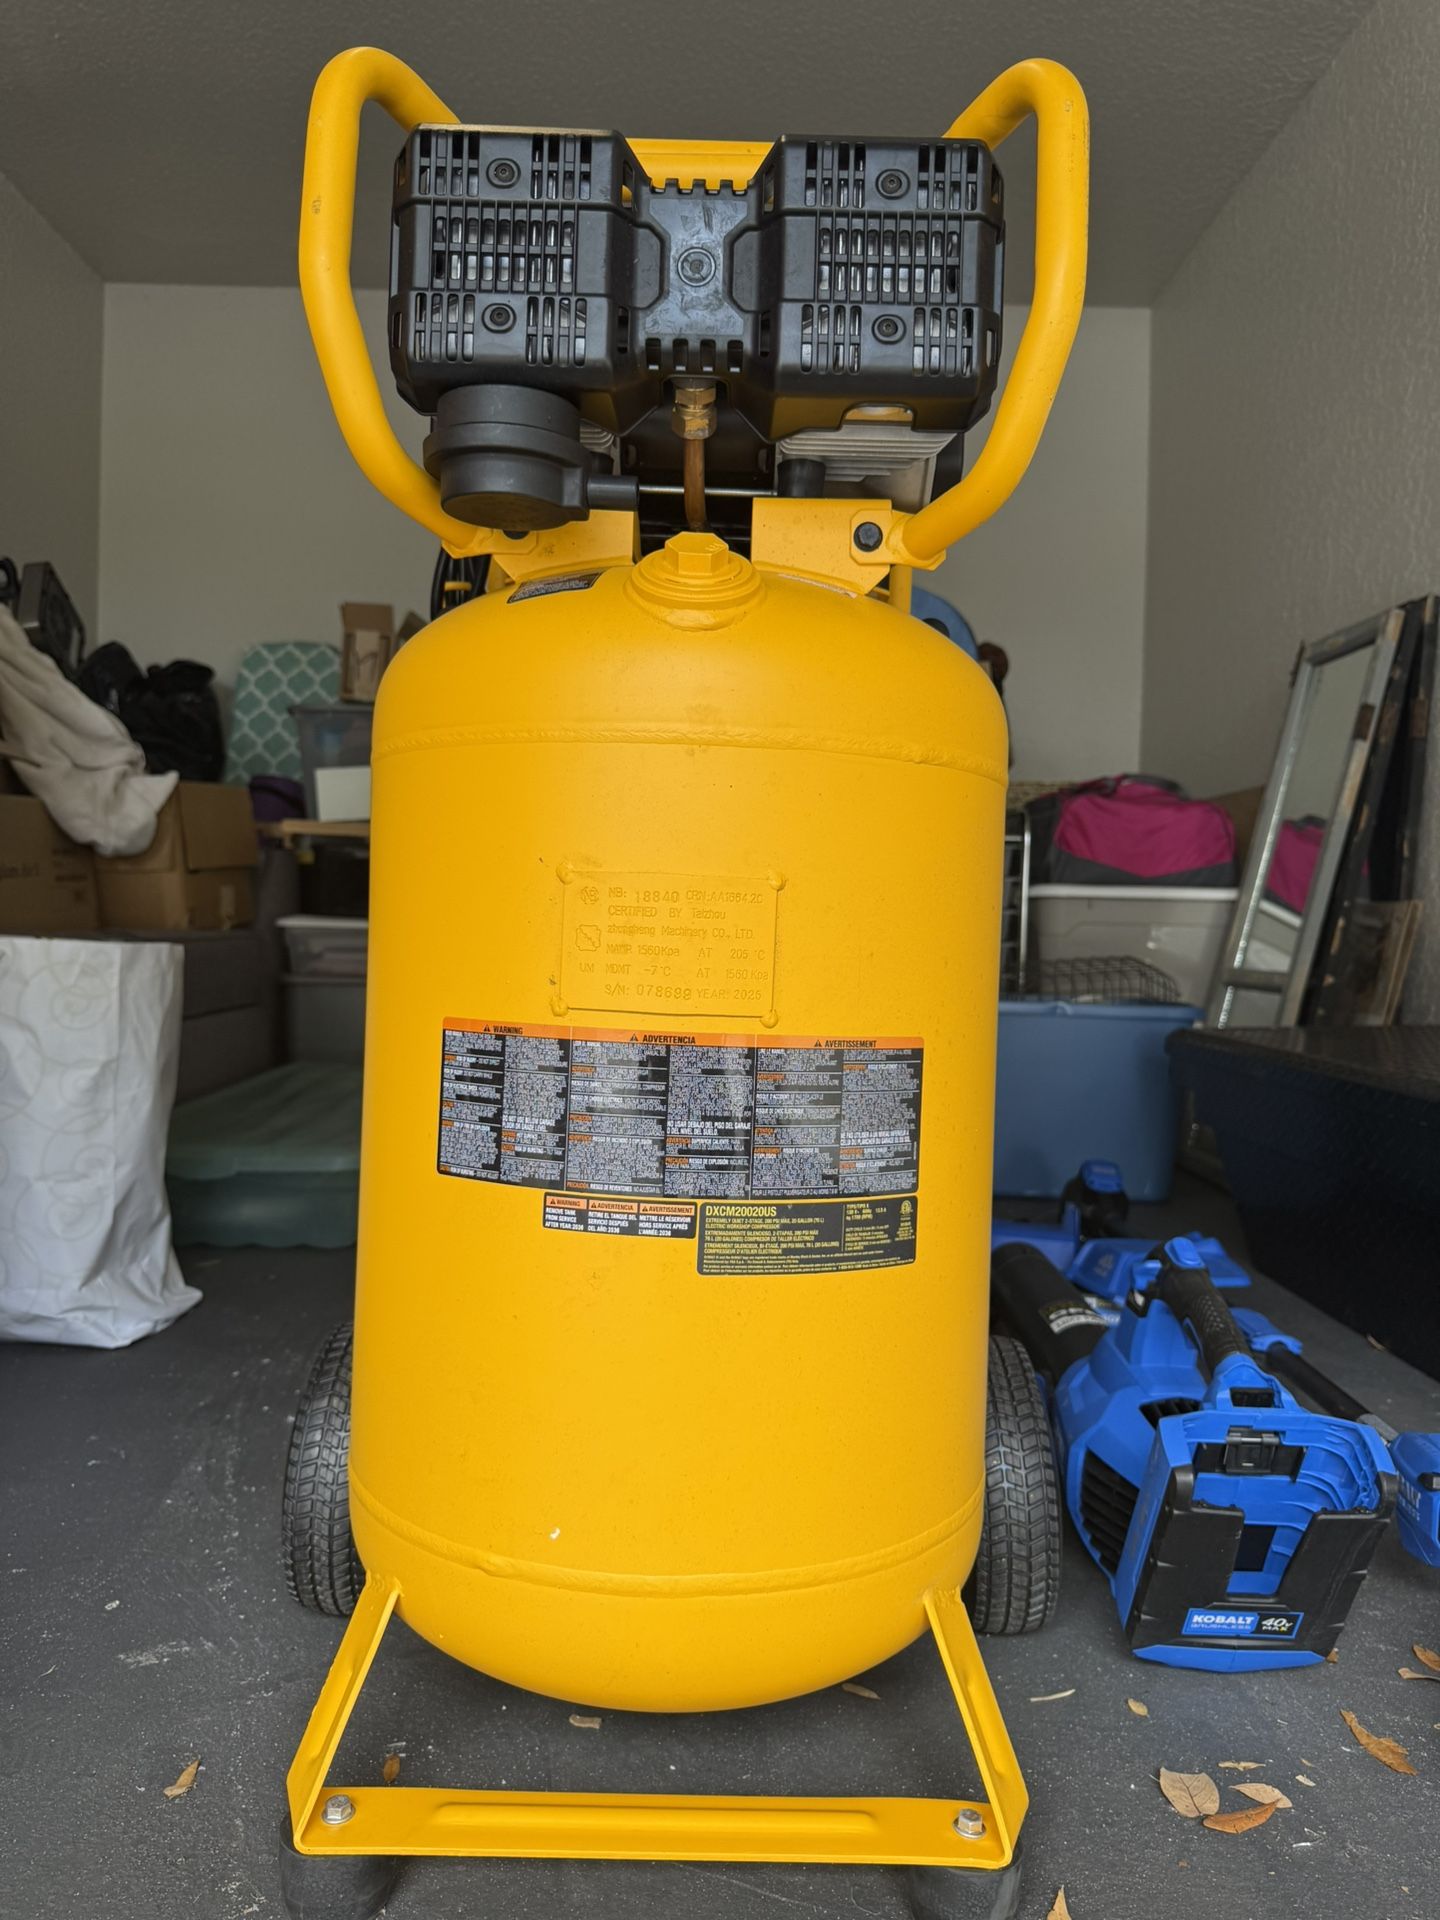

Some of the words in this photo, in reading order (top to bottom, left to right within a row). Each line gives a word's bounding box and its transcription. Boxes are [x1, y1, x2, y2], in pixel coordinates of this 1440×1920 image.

[608, 904, 657, 917] CERTIFIED
[668, 907, 682, 918] BY
[690, 908, 726, 920] Taizhou
[661, 925, 707, 940] Machinery
[698, 947, 713, 958] AT
[696, 967, 711, 978] AT
[604, 982, 630, 996] S/N:
[493, 1025, 524, 1035] WARNING
[642, 1034, 696, 1044] ADVERTENCIA
[824, 1040, 878, 1048] AVERTISSEMENT
[597, 1203, 634, 1211] ADVERTENCIA
[649, 1206, 693, 1214] AVERTISSEMENT
[705, 1206, 777, 1217] DXCM20020US
[639, 1214, 658, 1222] METTRE
[639, 1221, 652, 1229] HORS
[1192, 1615, 1255, 1624] KOBALT
